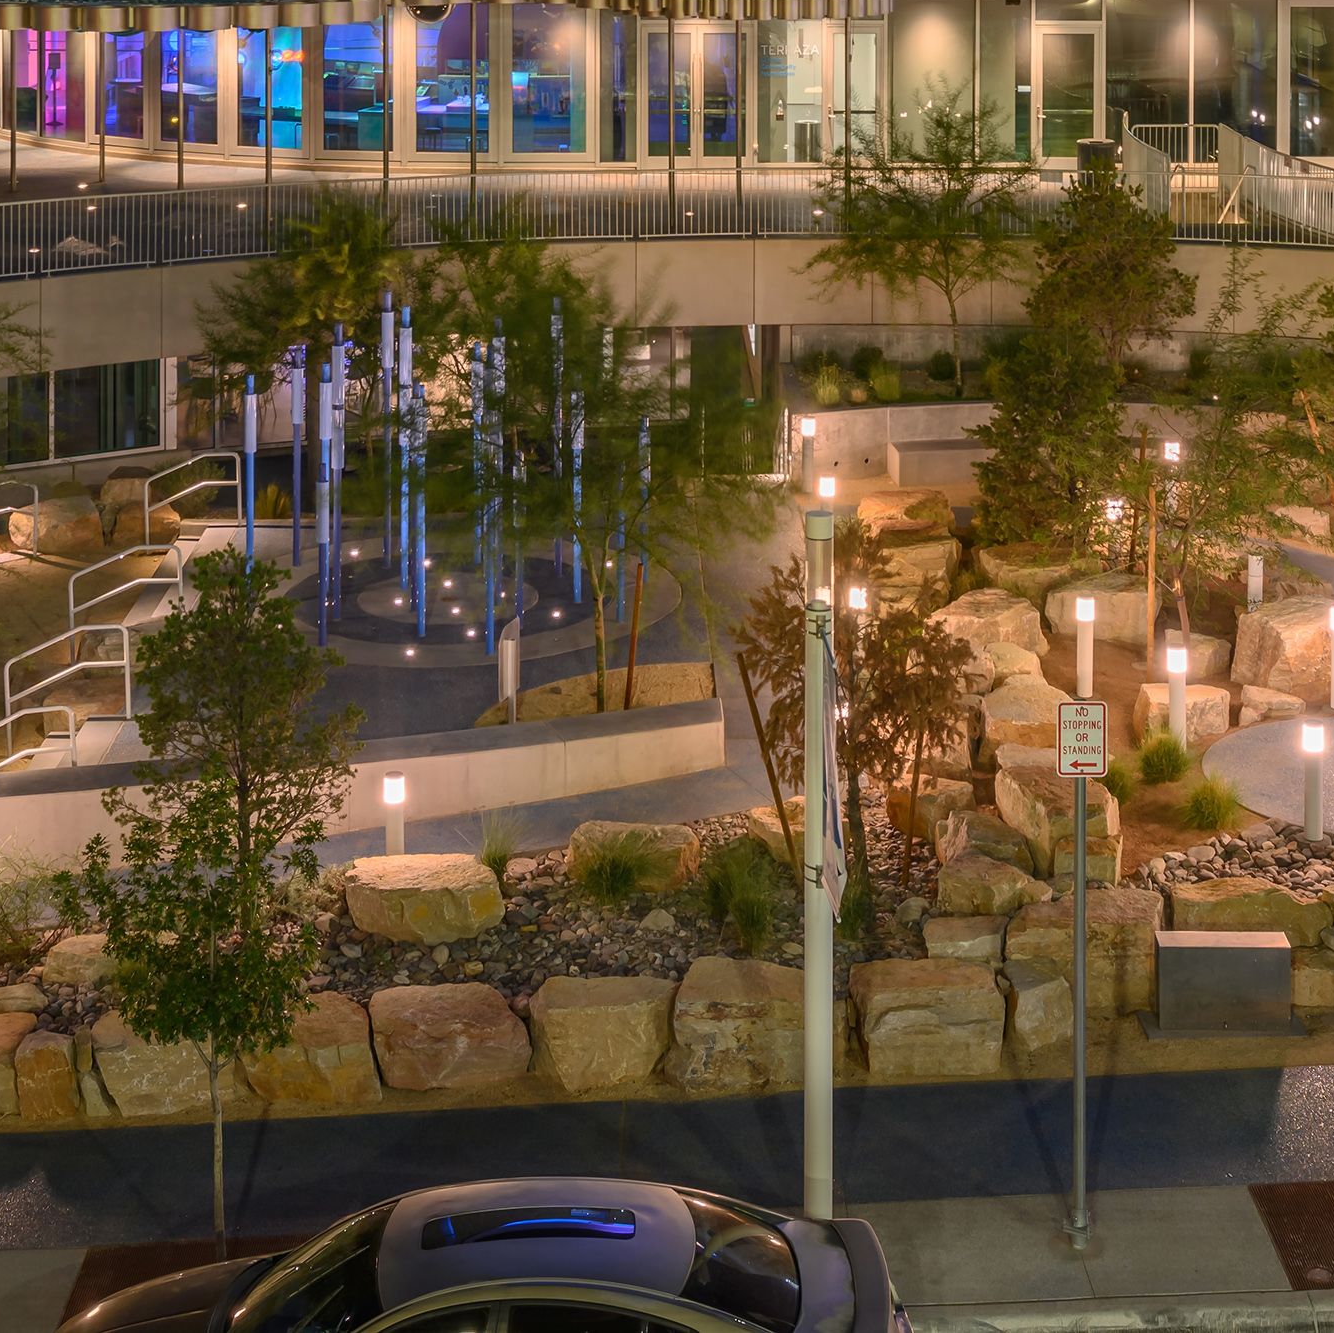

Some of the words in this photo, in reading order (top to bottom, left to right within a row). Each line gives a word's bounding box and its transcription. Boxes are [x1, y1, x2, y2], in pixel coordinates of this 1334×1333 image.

[1075, 708, 1089, 717] NO
[1062, 720, 1102, 730] STOPPING
[1075, 732, 1089, 742] OR
[1062, 745, 1102, 755] STANDING
